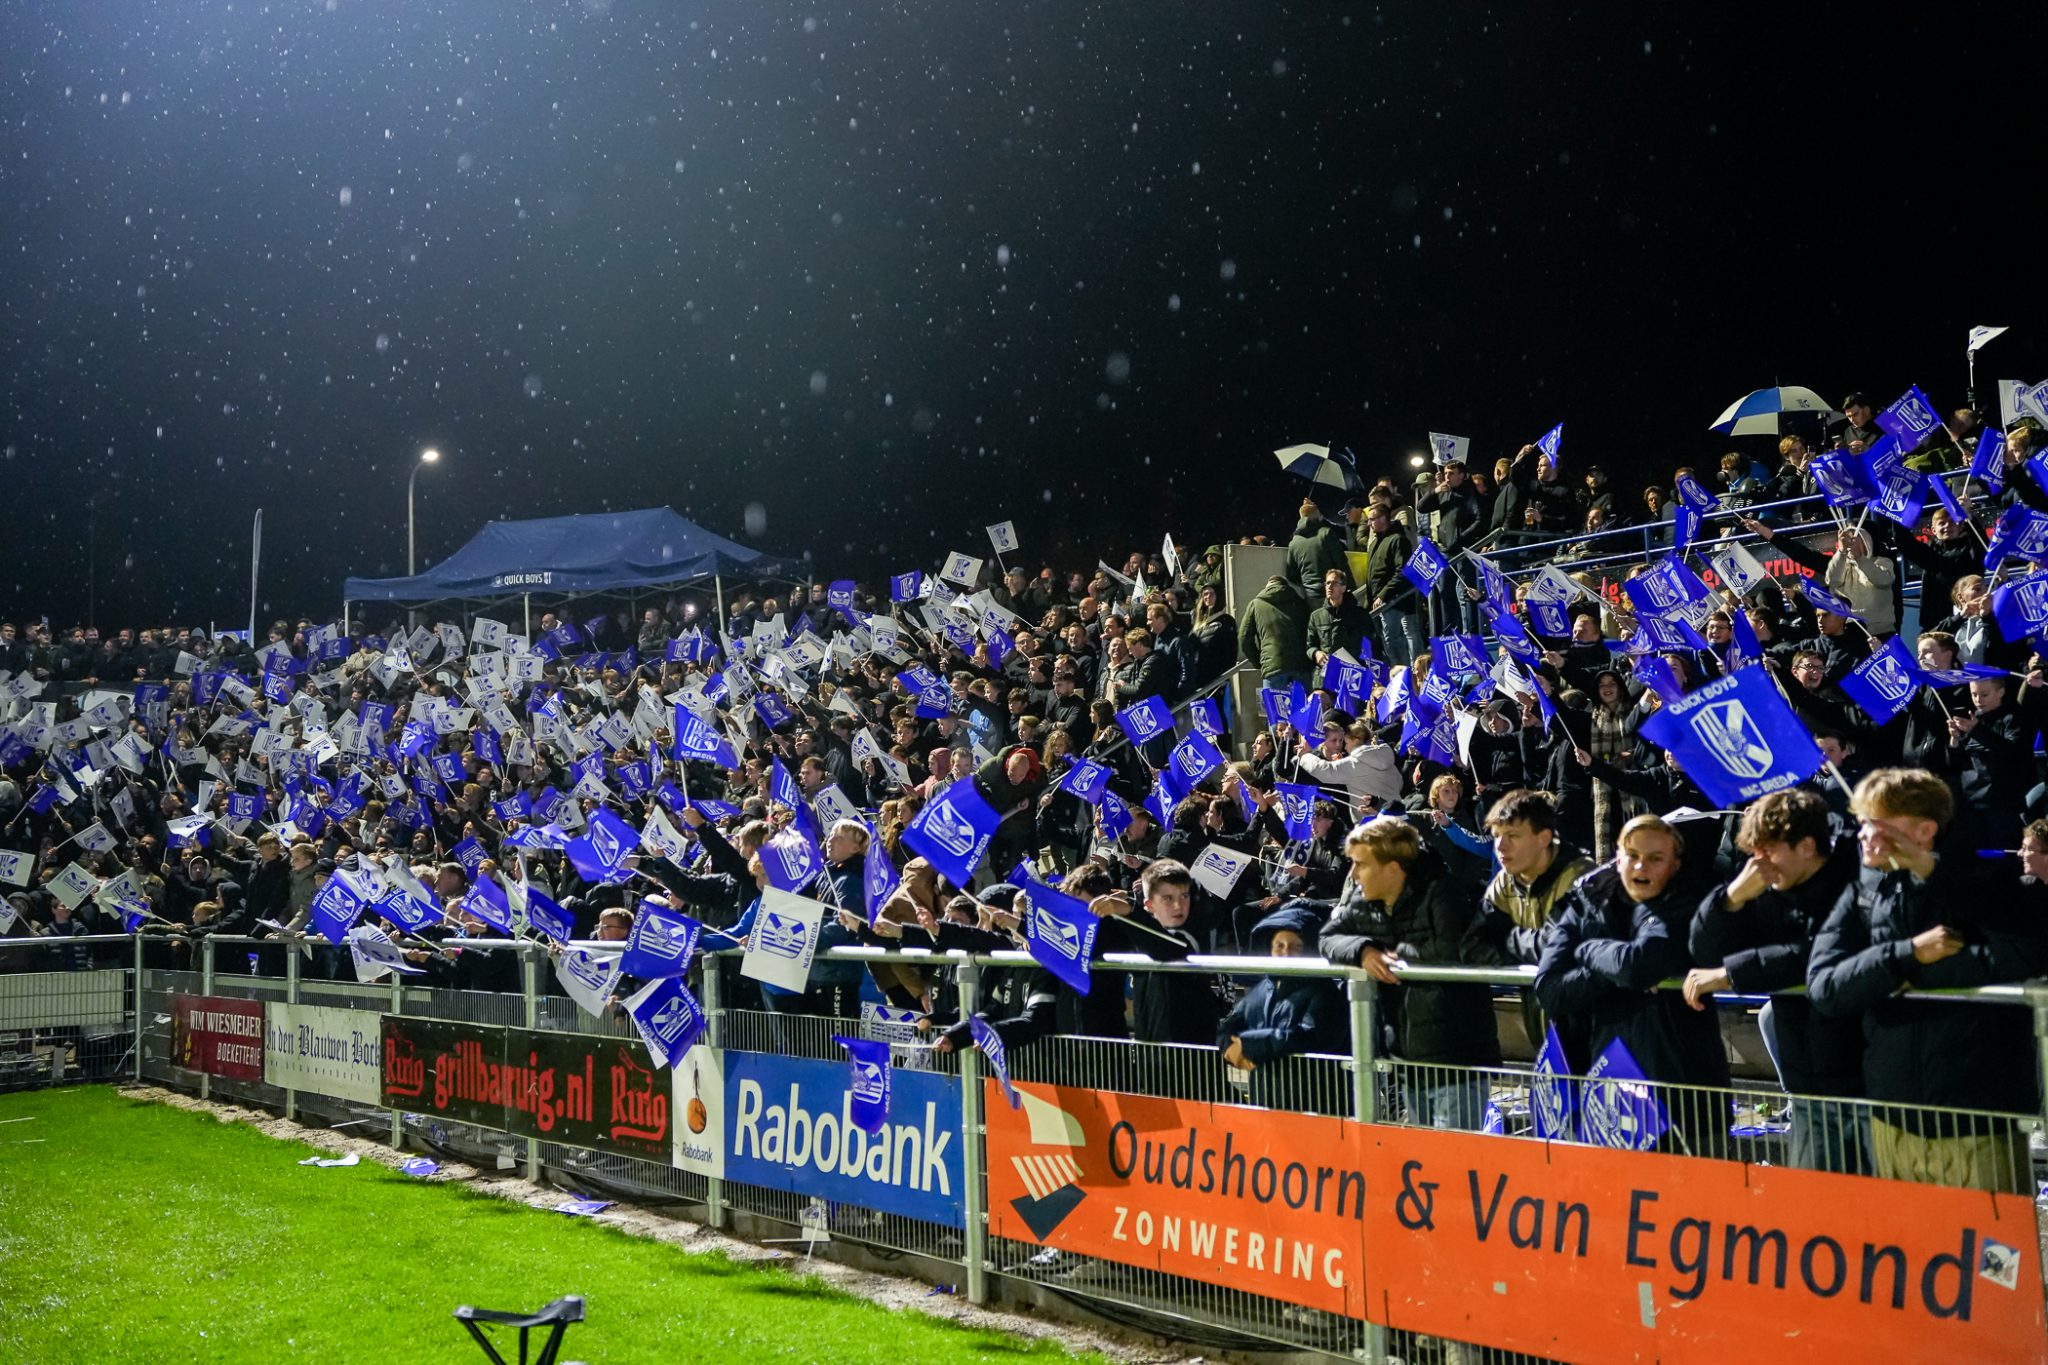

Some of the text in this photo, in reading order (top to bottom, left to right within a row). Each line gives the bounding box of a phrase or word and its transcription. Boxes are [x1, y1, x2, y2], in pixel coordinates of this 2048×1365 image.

[1887, 399, 1905, 413] QUICK
[1917, 431, 1929, 442] NAC
[1874, 506, 1903, 523] NAC BREDA
[504, 574, 542, 586] QUICK BOYS
[1635, 560, 1668, 581] QUICK BOYS
[2006, 577, 2028, 588] QUICK
[2026, 625, 2040, 635] NAC
[1854, 644, 1890, 676] QUICK BOYS
[1668, 676, 1738, 715] QUICK BOYS
[1891, 699, 1908, 714] NAC
[1122, 704, 1136, 715] QUICK
[1140, 735, 1151, 743] NAC
[692, 751, 716, 762] BREDA
[1200, 764, 1216, 779] BREDA
[1740, 772, 1799, 798] NAC BREDA
[616, 847, 633, 868] BREDA
[966, 833, 991, 872] NAC BREDA
[626, 904, 646, 952] QUICK BOYS
[748, 904, 766, 952] QUICK BOYS
[681, 926, 700, 969] NAC BREDA
[803, 922, 819, 969] NAC BREDA
[1082, 923, 1096, 957] BREDA
[207, 1012, 261, 1038] WIESMEIJER
[217, 1042, 261, 1067] BOEKETTERIE
[279, 1025, 294, 1054] den
[299, 1024, 348, 1062] Blauwen
[654, 1035, 670, 1056] QUICK
[734, 1078, 952, 1196] Rabobank
[682, 1142, 713, 1163] Rabobank
[1108, 1120, 1976, 1322] Oudshoorn & Van Egmond
[1112, 1206, 1344, 1288] ZONWERING
